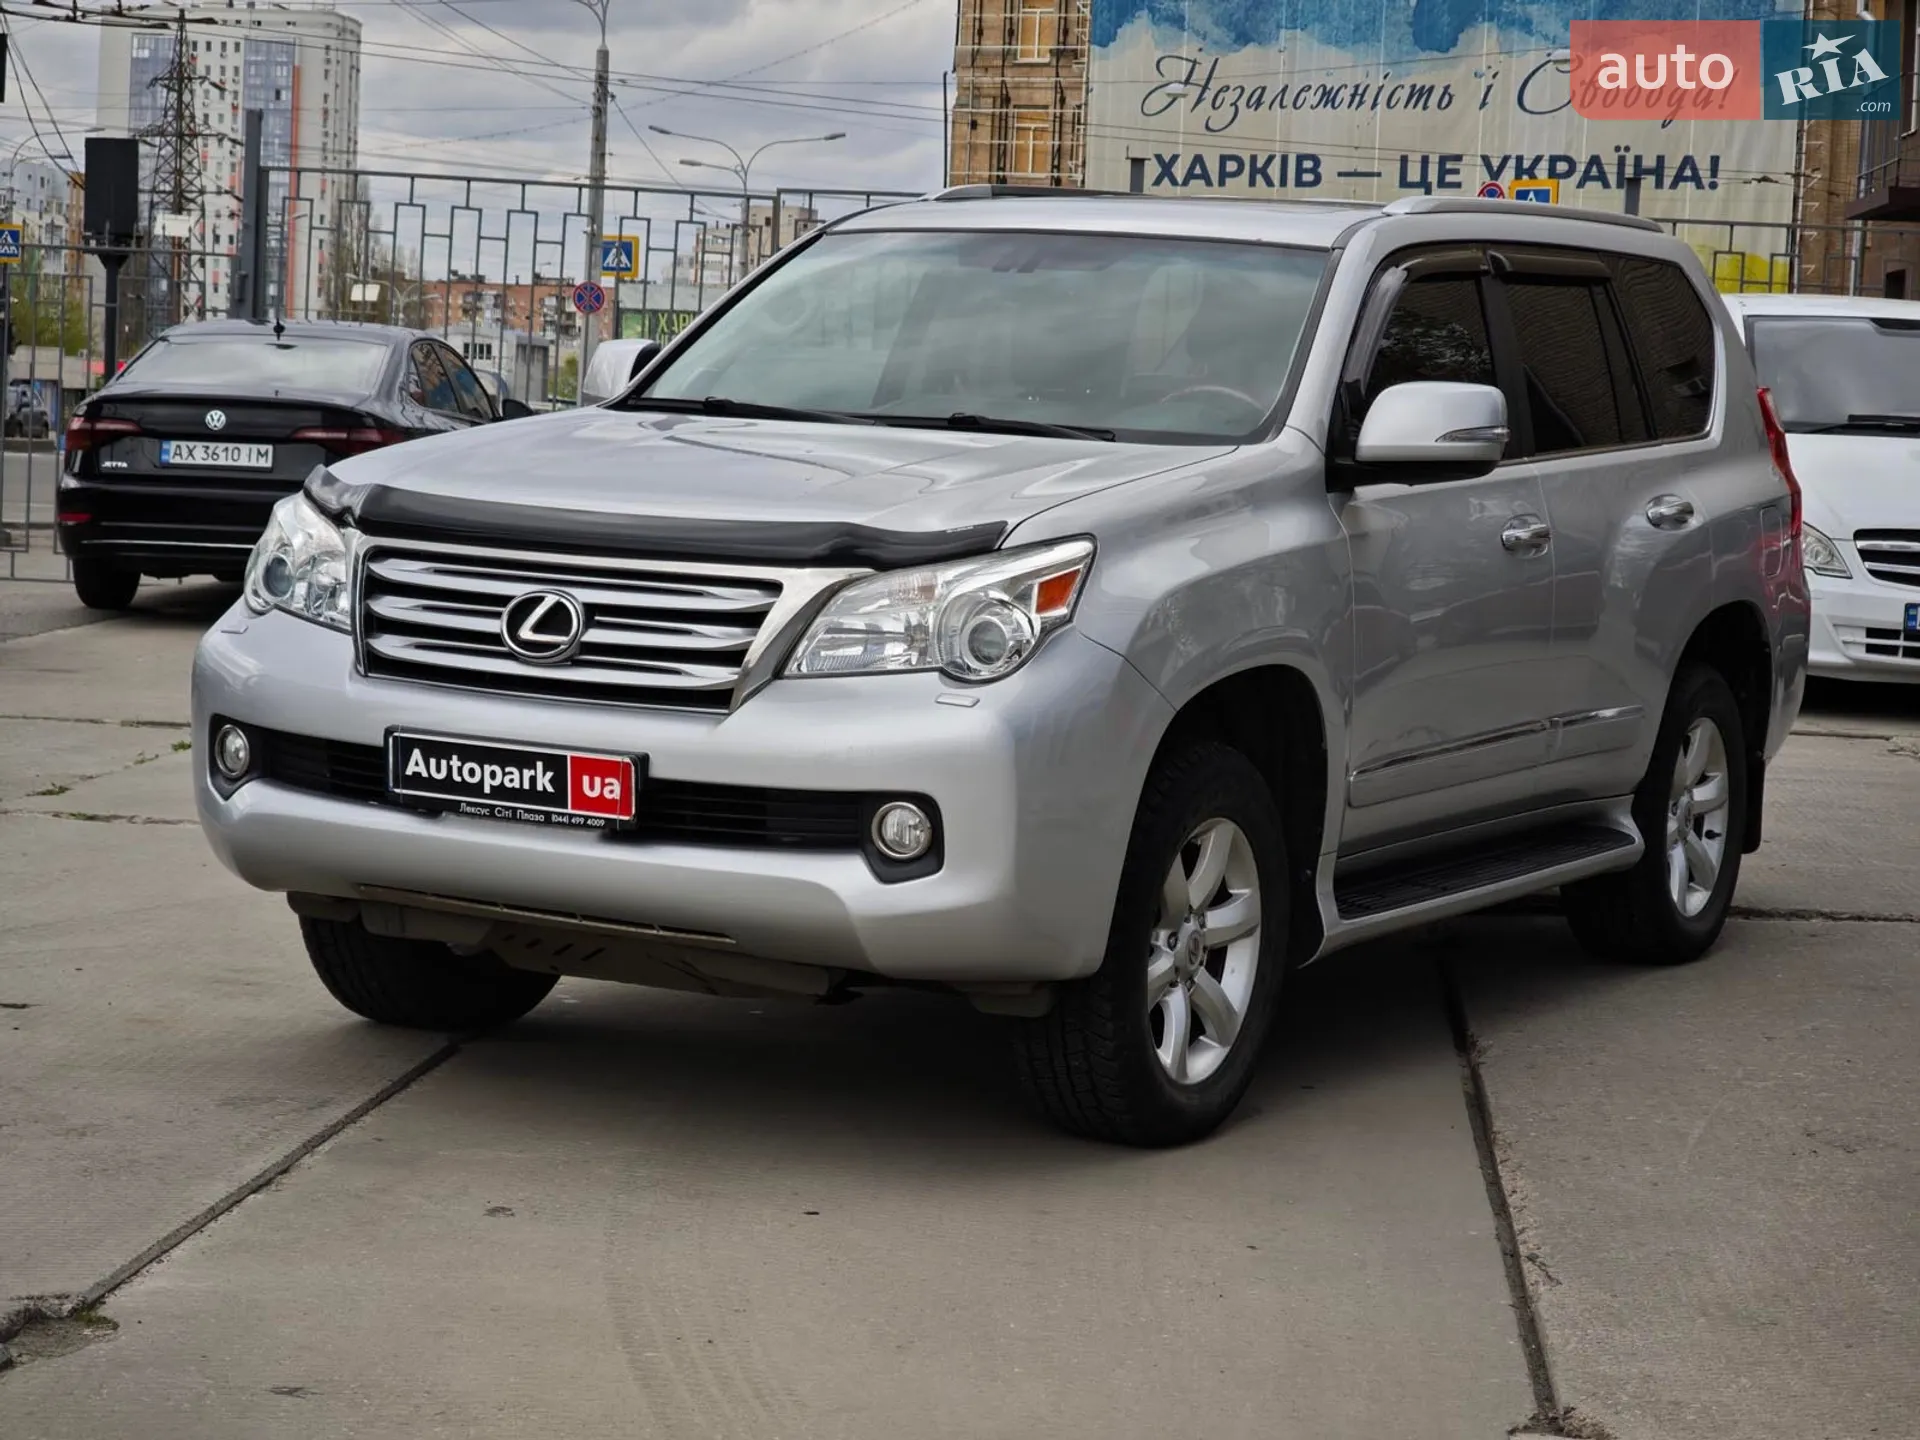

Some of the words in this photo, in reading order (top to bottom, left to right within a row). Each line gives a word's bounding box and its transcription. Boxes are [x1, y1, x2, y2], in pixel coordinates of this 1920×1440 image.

[1141, 55, 1456, 133] Незалежність
[1152, 153, 1323, 188] ХАРКІВ
[1398, 154, 1465, 196] ЦЕ
[1480, 144, 1721, 191] УКРАЇНА!
[172, 444, 197, 461] AX
[201, 446, 241, 462] 3610
[247, 448, 269, 464] IM
[405, 748, 555, 794] Autopark
[581, 774, 620, 800] ua
[459, 802, 490, 816] Лексус
[571, 817, 585, 825] 499
[586, 818, 605, 827] 4009
